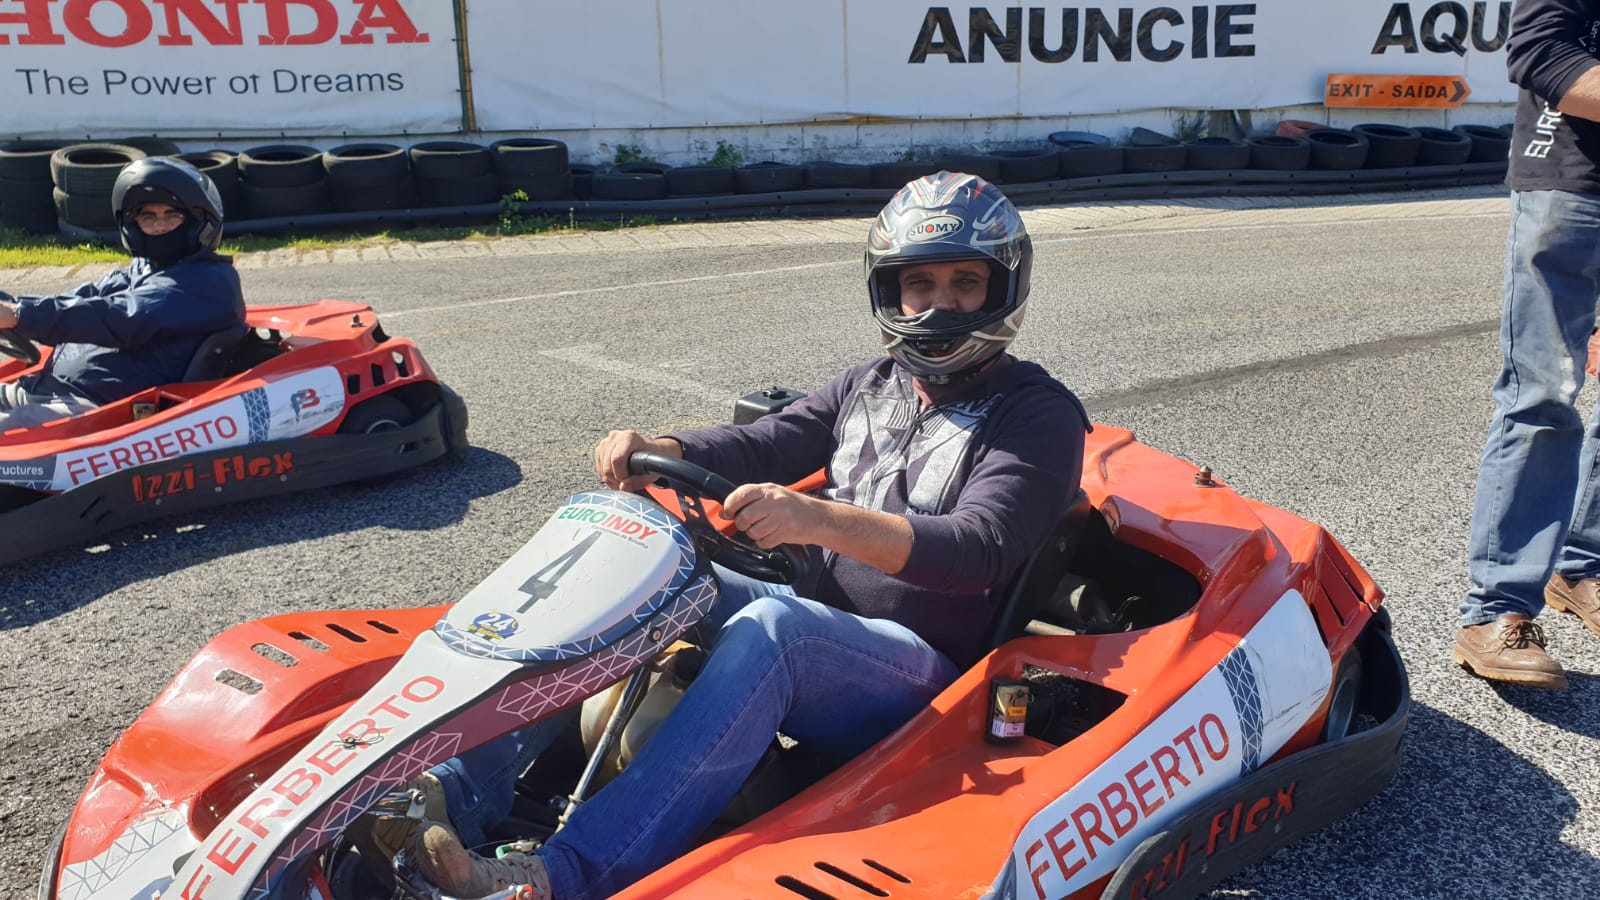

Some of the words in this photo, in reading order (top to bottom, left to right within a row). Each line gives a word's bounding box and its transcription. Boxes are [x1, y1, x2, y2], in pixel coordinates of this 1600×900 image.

[0, 0, 430, 48] HONDA
[908, 4, 1256, 63] ANUNCIE
[1371, 1, 1512, 57] AQU
[15, 69, 89, 95] The
[103, 69, 216, 95] Power
[272, 69, 404, 94] Dreams
[1329, 84, 1374, 98] EXIT
[1392, 81, 1449, 99] SAÍDA
[910, 223, 959, 236] SUOMY
[66, 416, 238, 486] FERBERTO
[558, 507, 659, 541] EUROINDY
[516, 530, 602, 614] 4
[477, 613, 515, 630] 24
[181, 676, 446, 900] FERBERTO
[1025, 713, 1230, 900] FERBERTO
